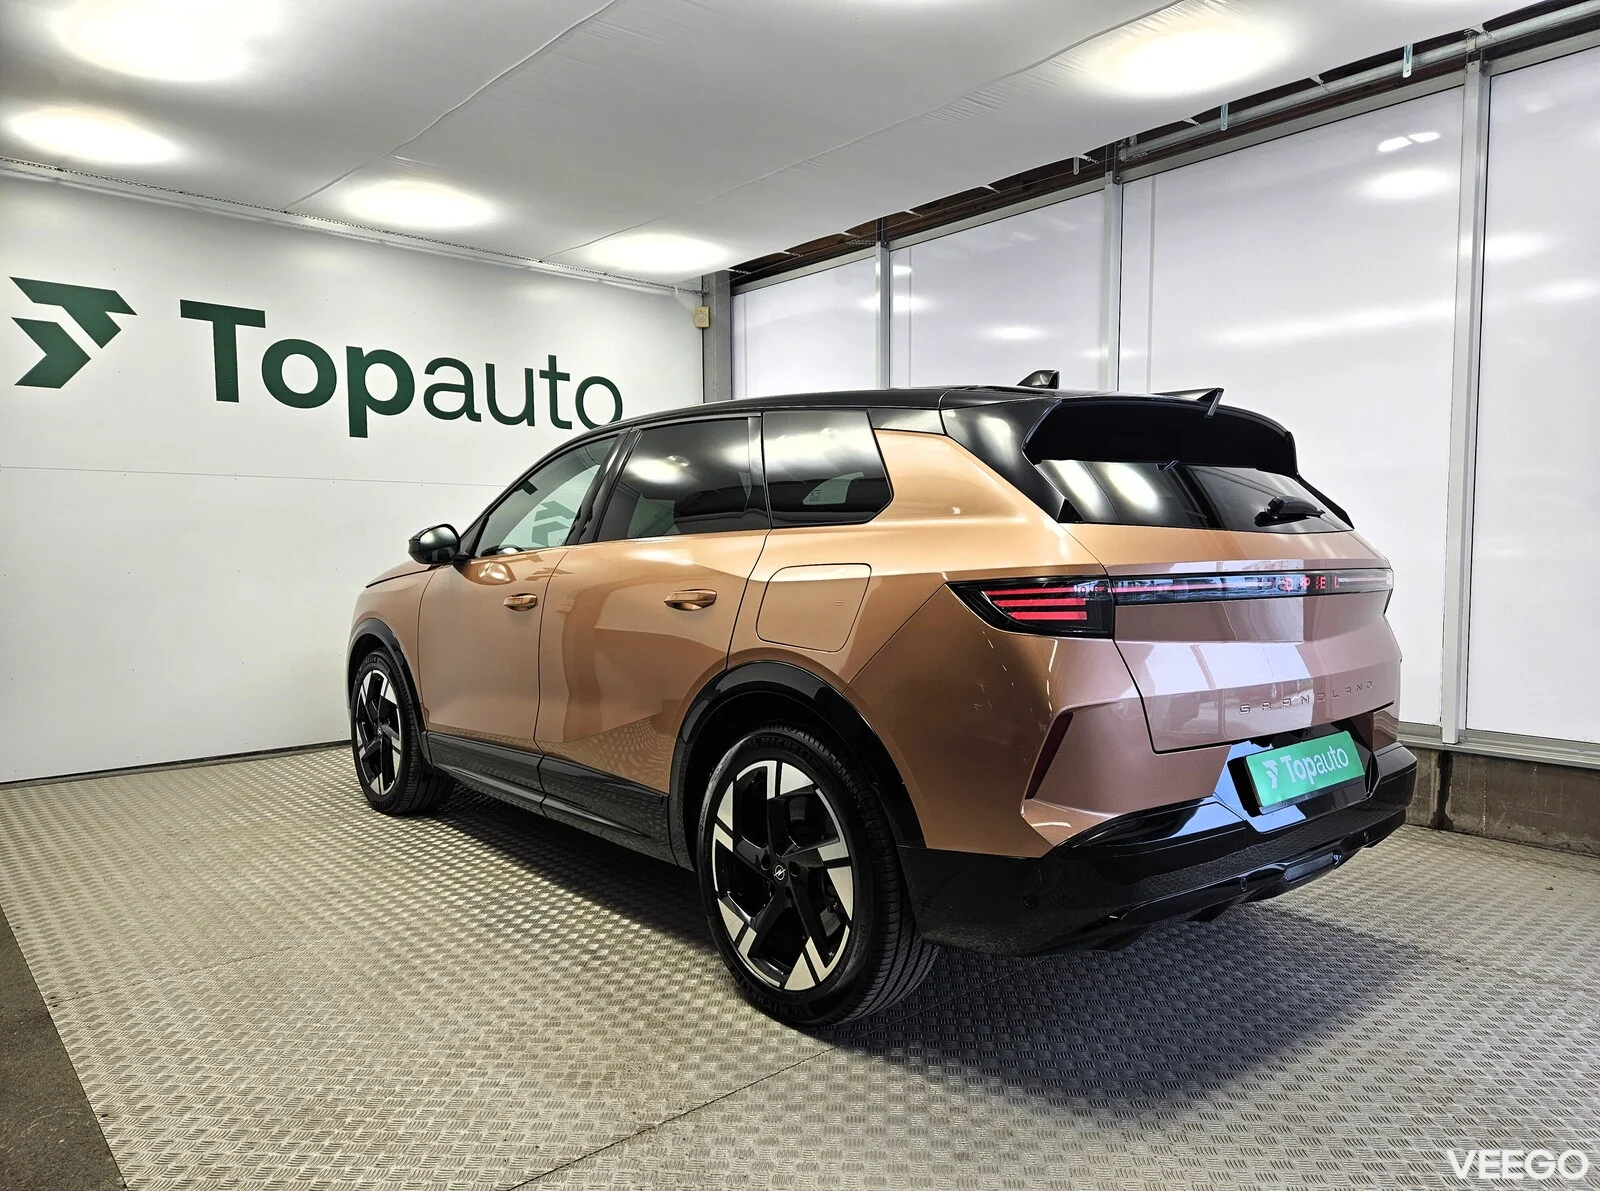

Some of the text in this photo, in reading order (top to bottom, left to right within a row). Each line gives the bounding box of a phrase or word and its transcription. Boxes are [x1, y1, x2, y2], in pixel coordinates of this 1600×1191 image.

[180, 299, 623, 438] Topauto
[1239, 680, 1373, 714] GRANDLAND
[1280, 746, 1349, 785] Topauto
